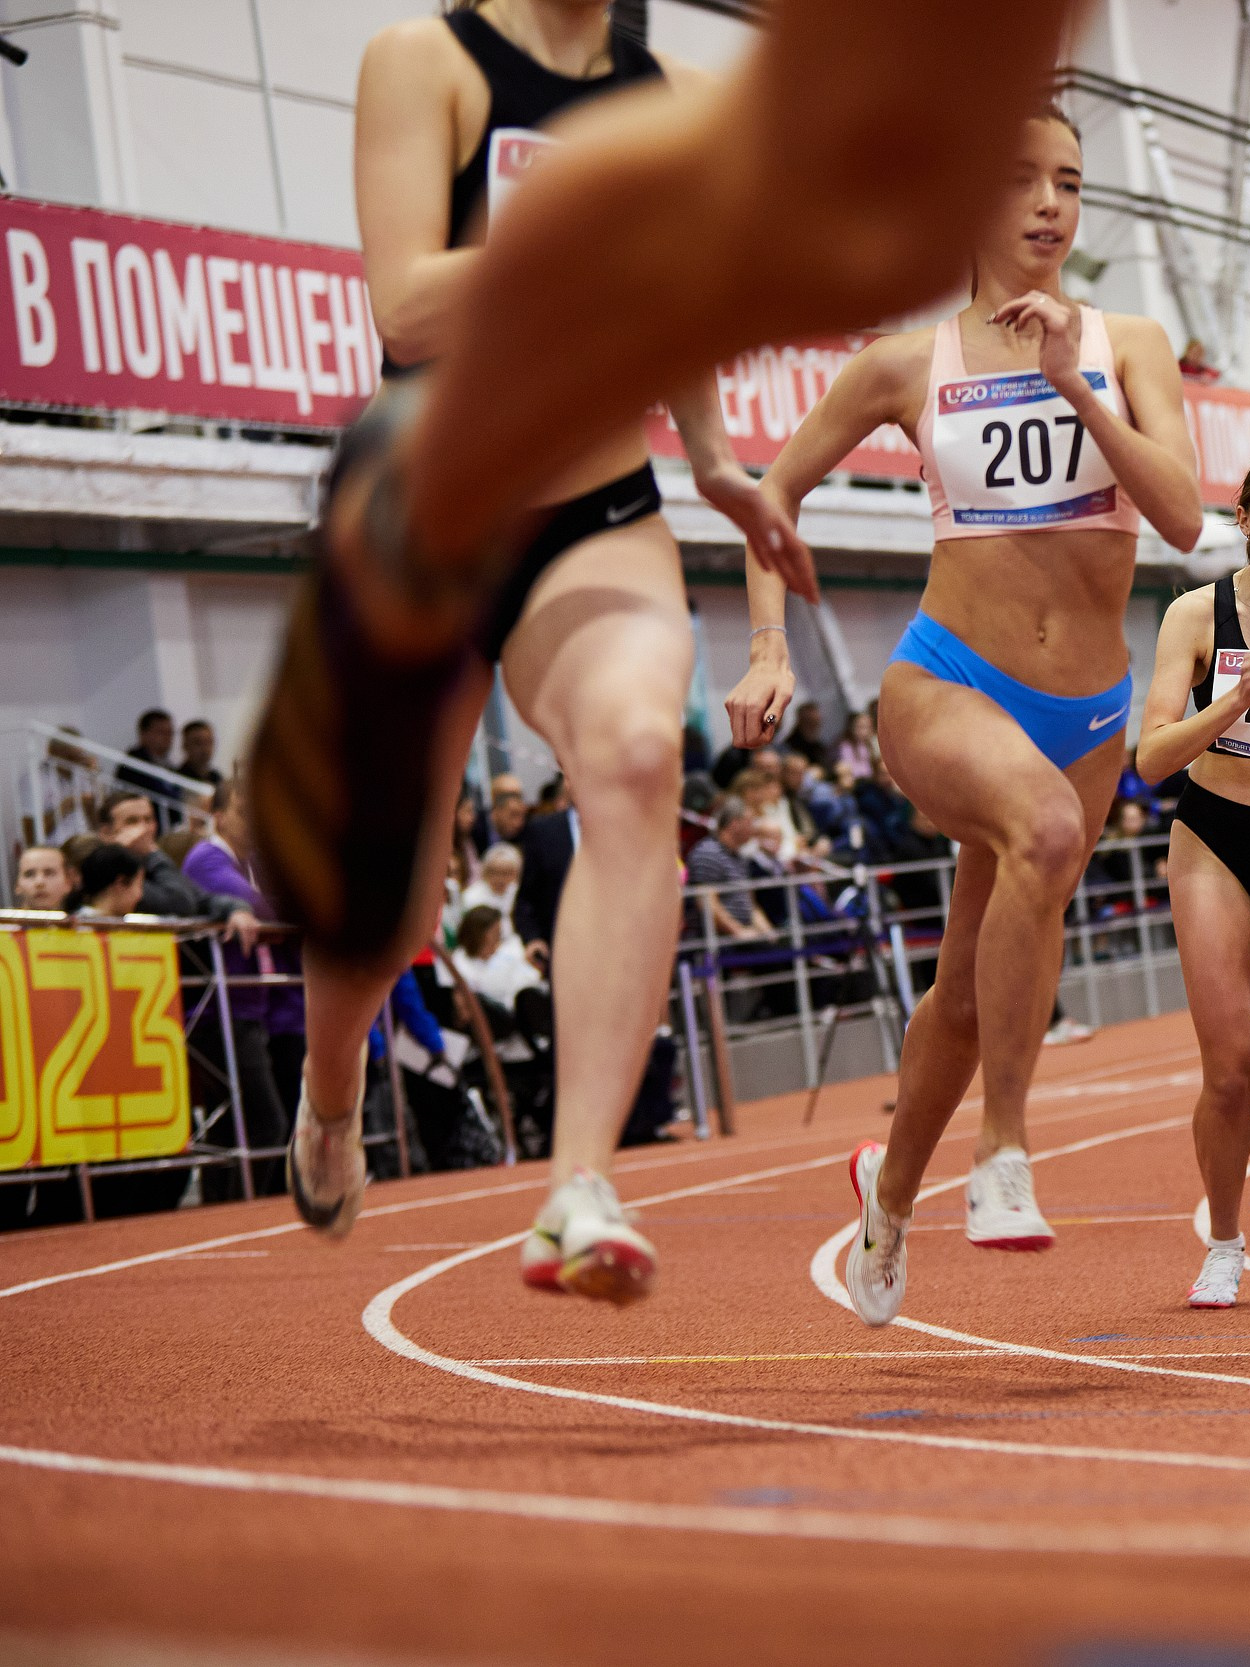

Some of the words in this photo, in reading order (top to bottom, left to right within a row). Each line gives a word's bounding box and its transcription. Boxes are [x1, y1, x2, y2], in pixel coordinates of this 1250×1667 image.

[6, 228, 57, 367] В
[945, 384, 988, 405] U20
[982, 415, 1085, 489] 207
[1225, 655, 1245, 668] U2
